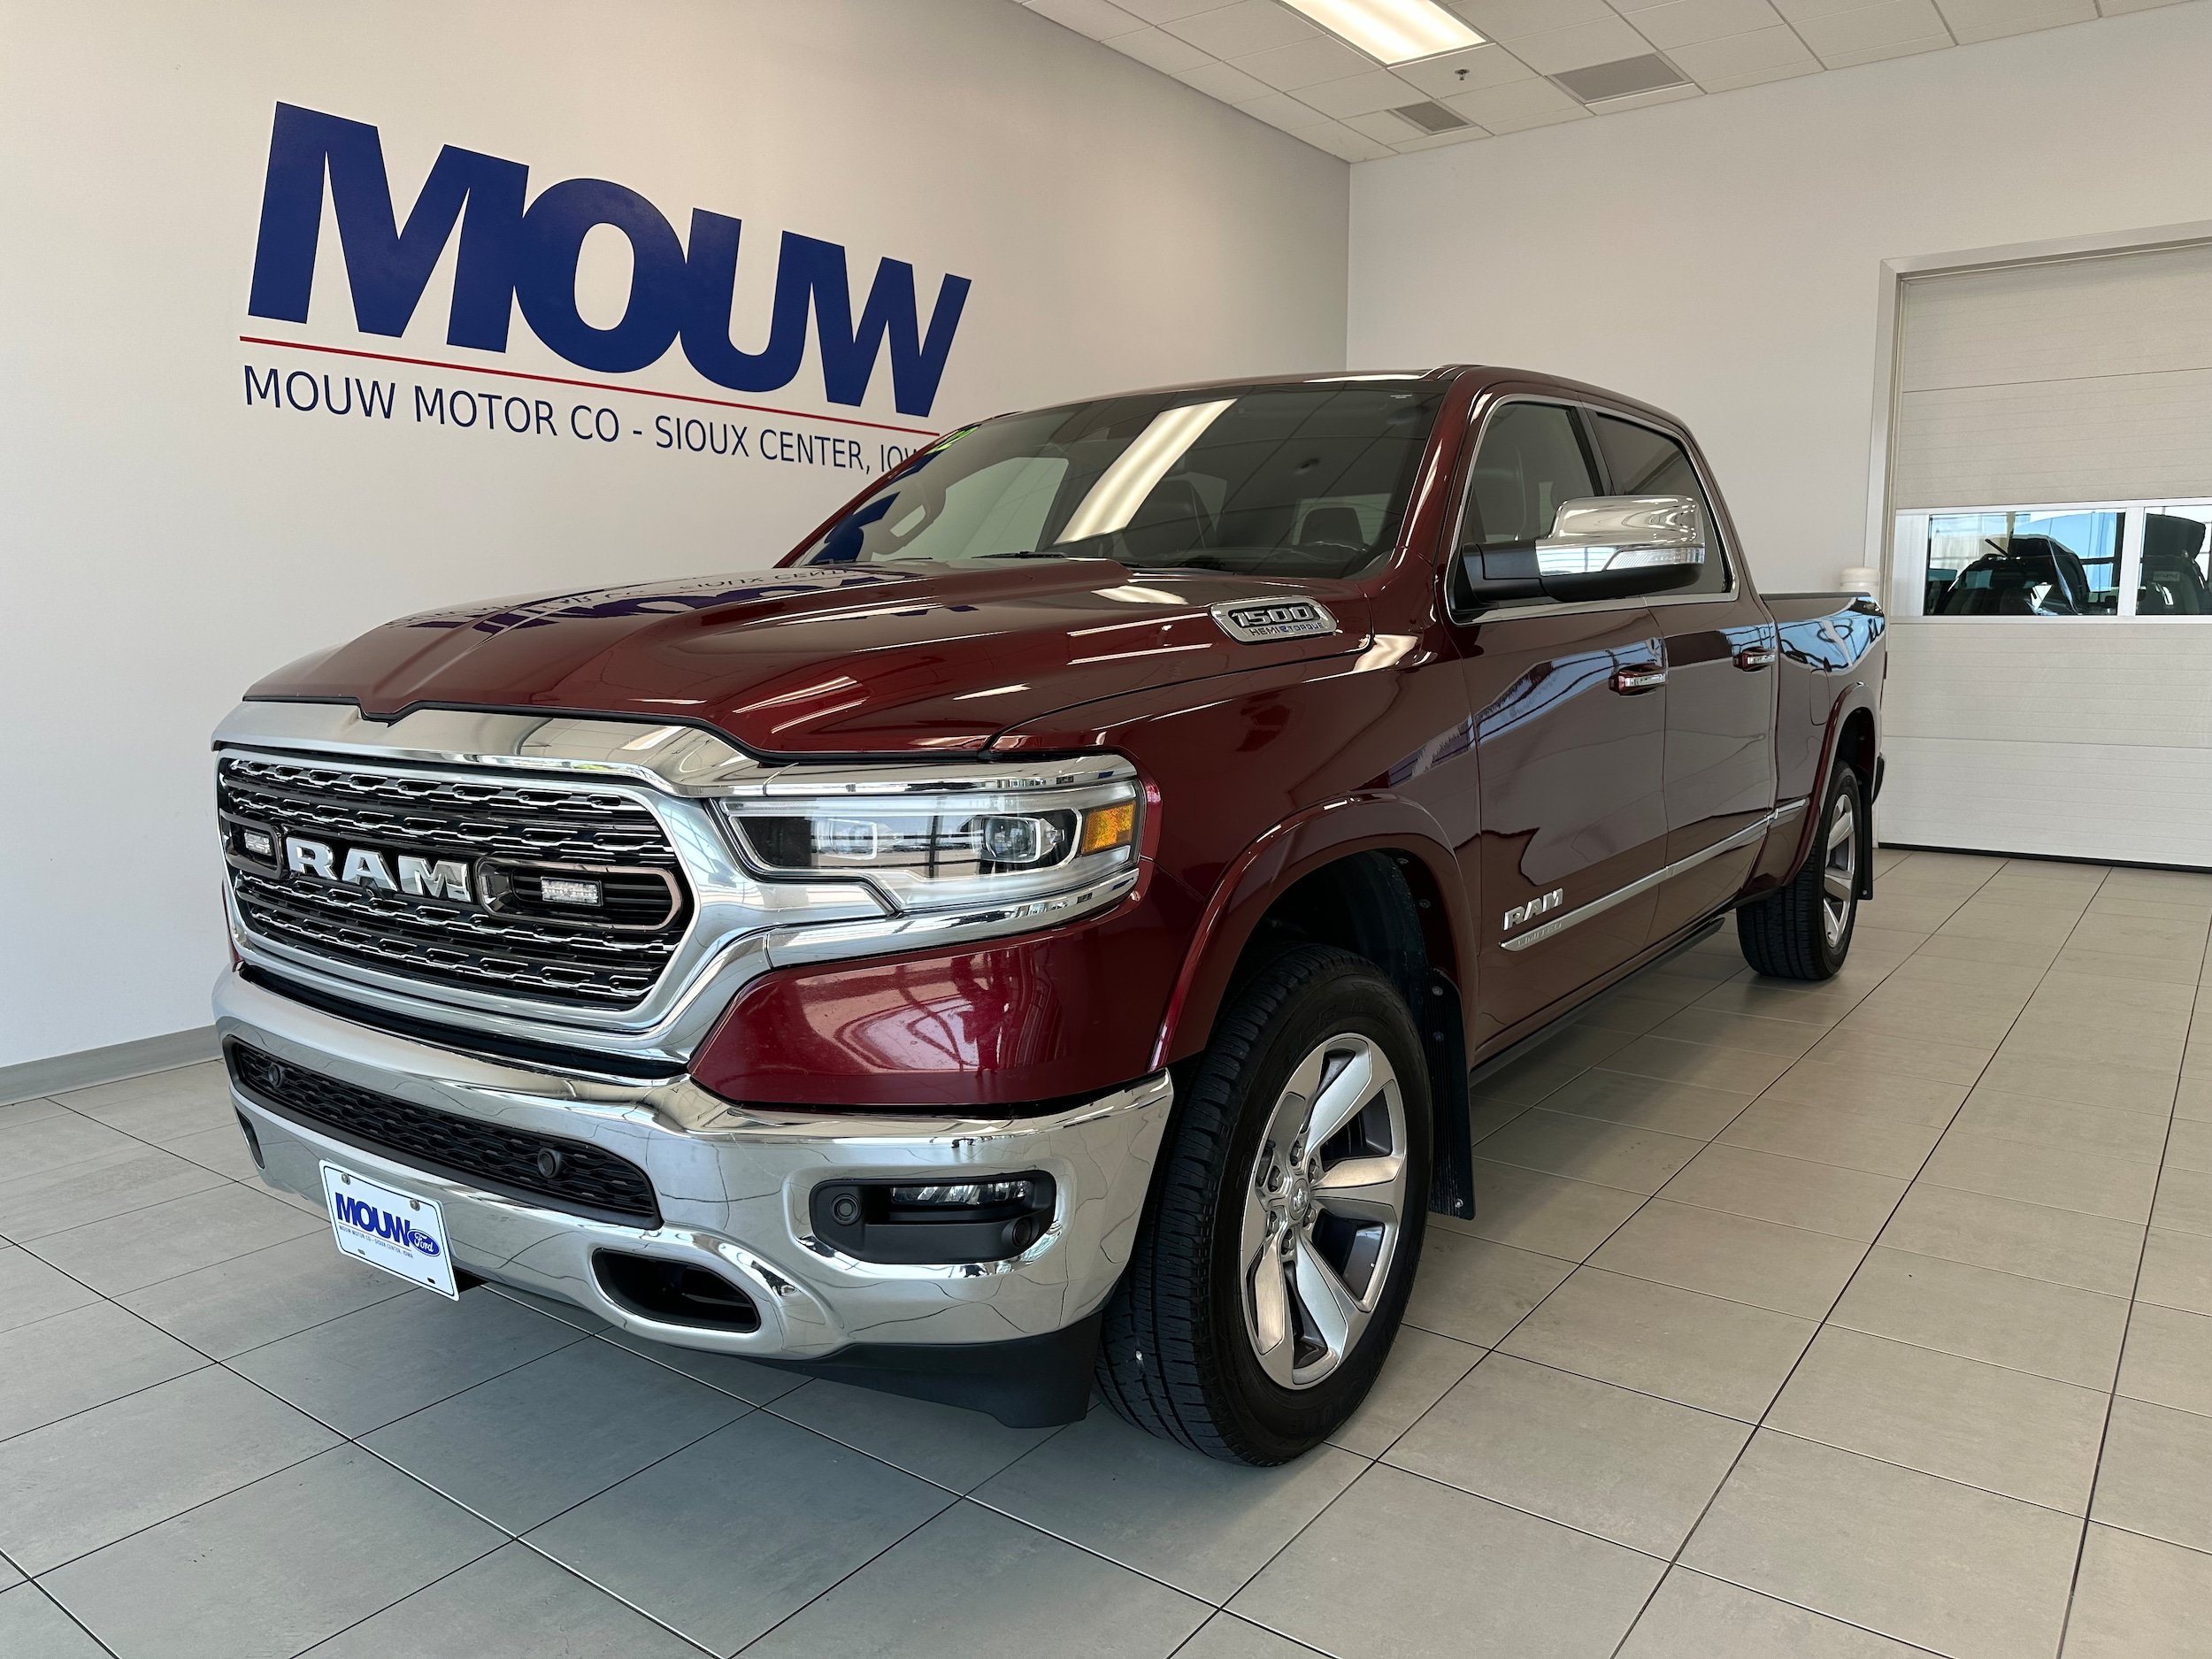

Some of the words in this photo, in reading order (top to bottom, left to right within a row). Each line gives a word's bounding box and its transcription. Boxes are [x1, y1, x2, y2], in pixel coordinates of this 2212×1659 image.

[248, 101, 972, 418] MOUW
[244, 365, 396, 420] MOUW
[414, 385, 558, 437] MOTOR
[571, 404, 620, 443] CO
[655, 415, 749, 457] SIOUX
[760, 429, 871, 475] CENTER,
[1232, 605, 1316, 627] 1500
[1248, 626, 1281, 636] HEMI
[286, 836, 472, 902] RAM
[1503, 887, 1563, 931] RAM
[335, 1192, 411, 1248] MOUW
[413, 1232, 434, 1253] Ford
